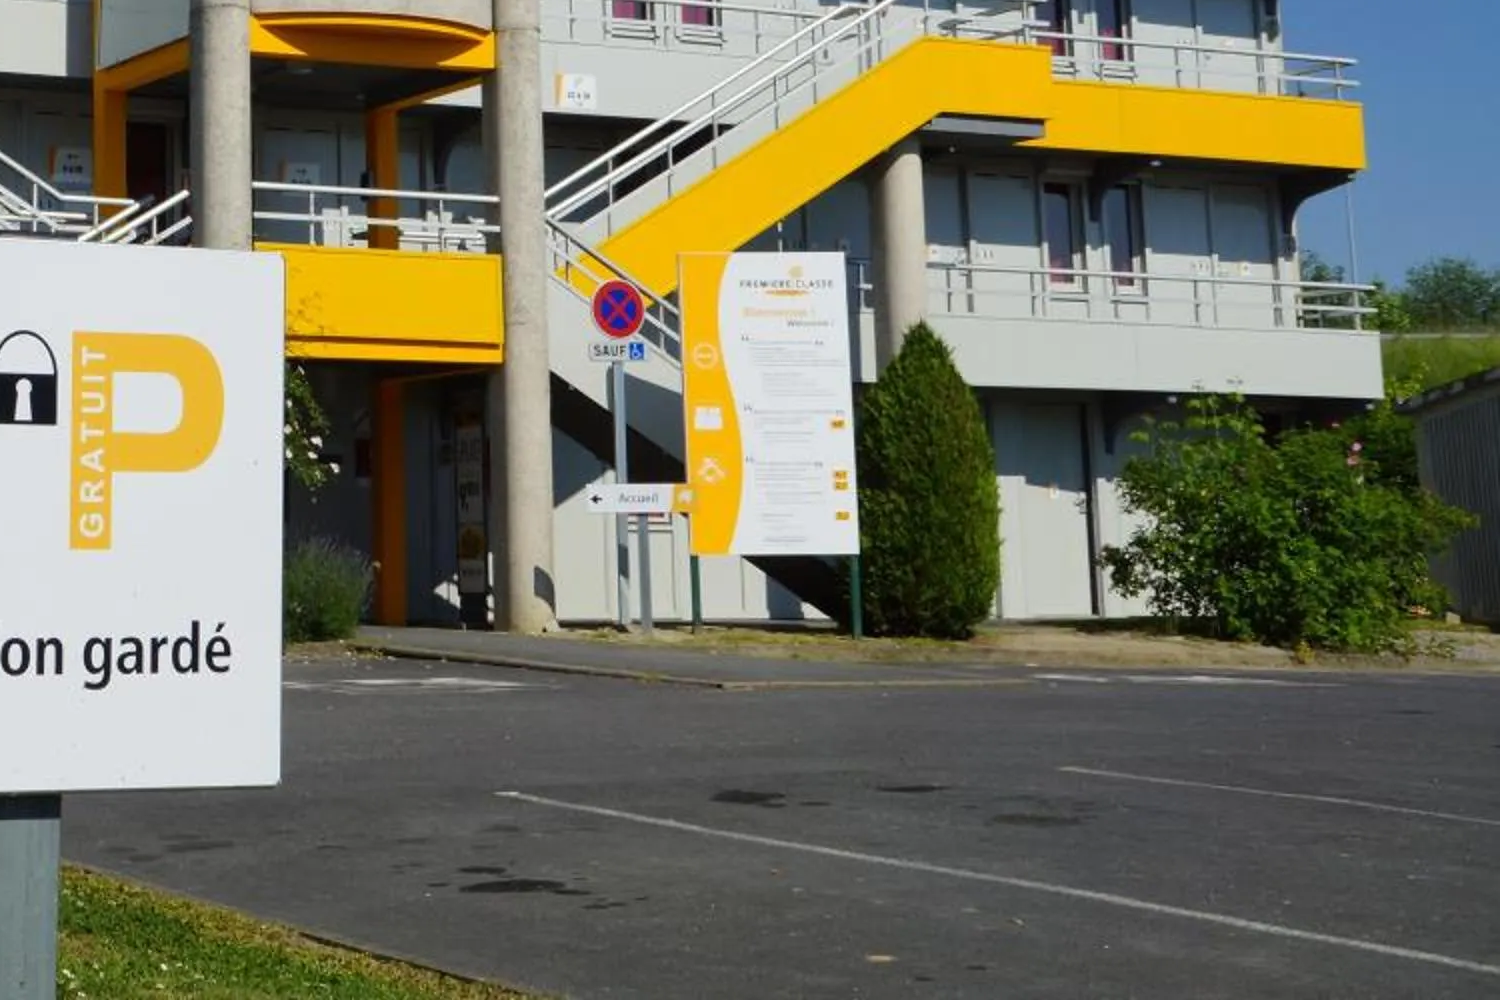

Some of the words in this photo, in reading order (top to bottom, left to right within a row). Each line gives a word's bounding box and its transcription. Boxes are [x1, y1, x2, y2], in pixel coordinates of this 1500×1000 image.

[593, 343, 627, 357] SAUF
[70, 331, 226, 549] P
[79, 345, 107, 538] GRATUIT
[83, 620, 232, 690] gardé
